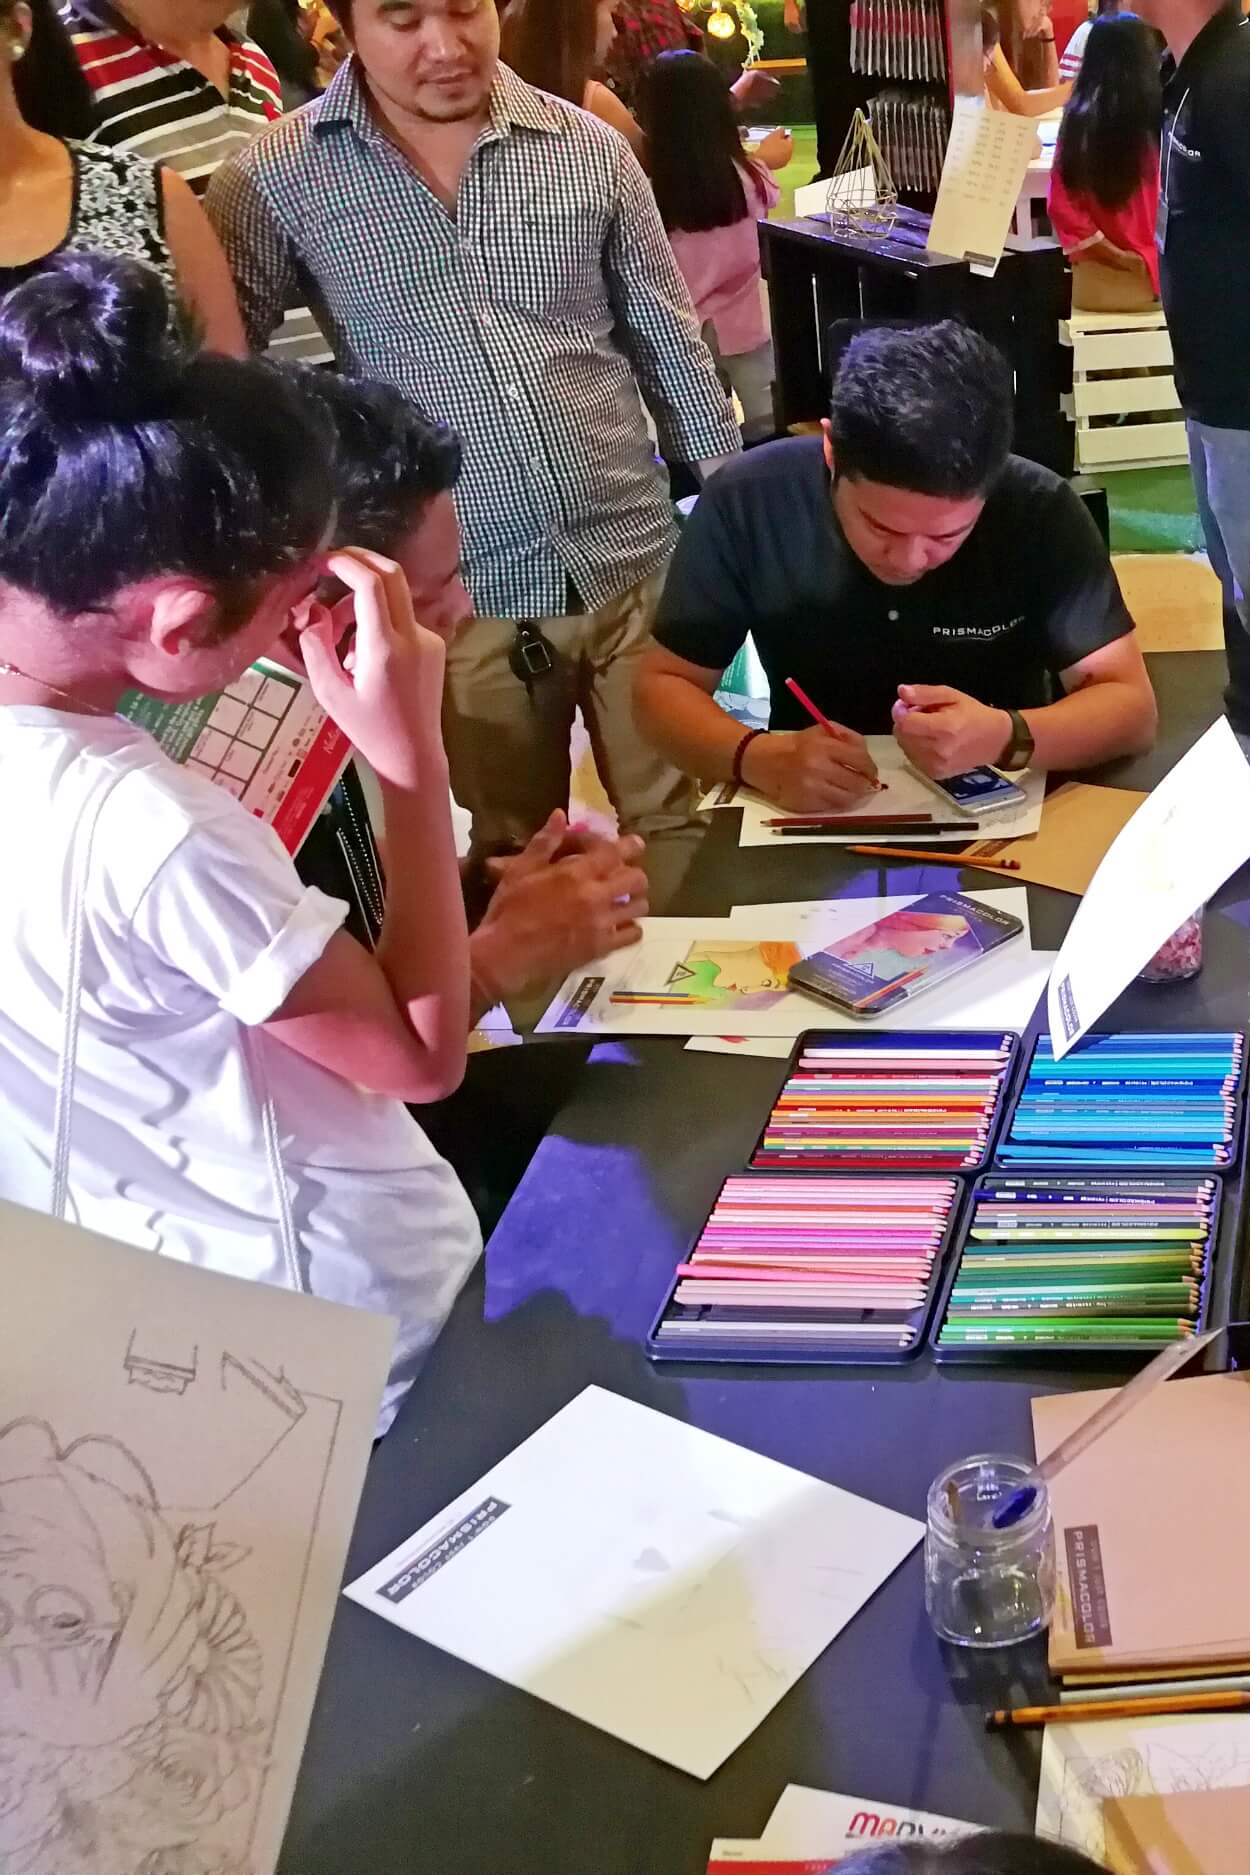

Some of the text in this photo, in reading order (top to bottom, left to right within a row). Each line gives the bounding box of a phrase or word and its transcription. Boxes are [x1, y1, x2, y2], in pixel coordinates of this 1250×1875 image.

[938, 894, 1010, 927] PRISMACOLOR
[386, 1500, 498, 1596] PRISMACOLOR
[1073, 1530, 1096, 1644] PRISMACOLOR
